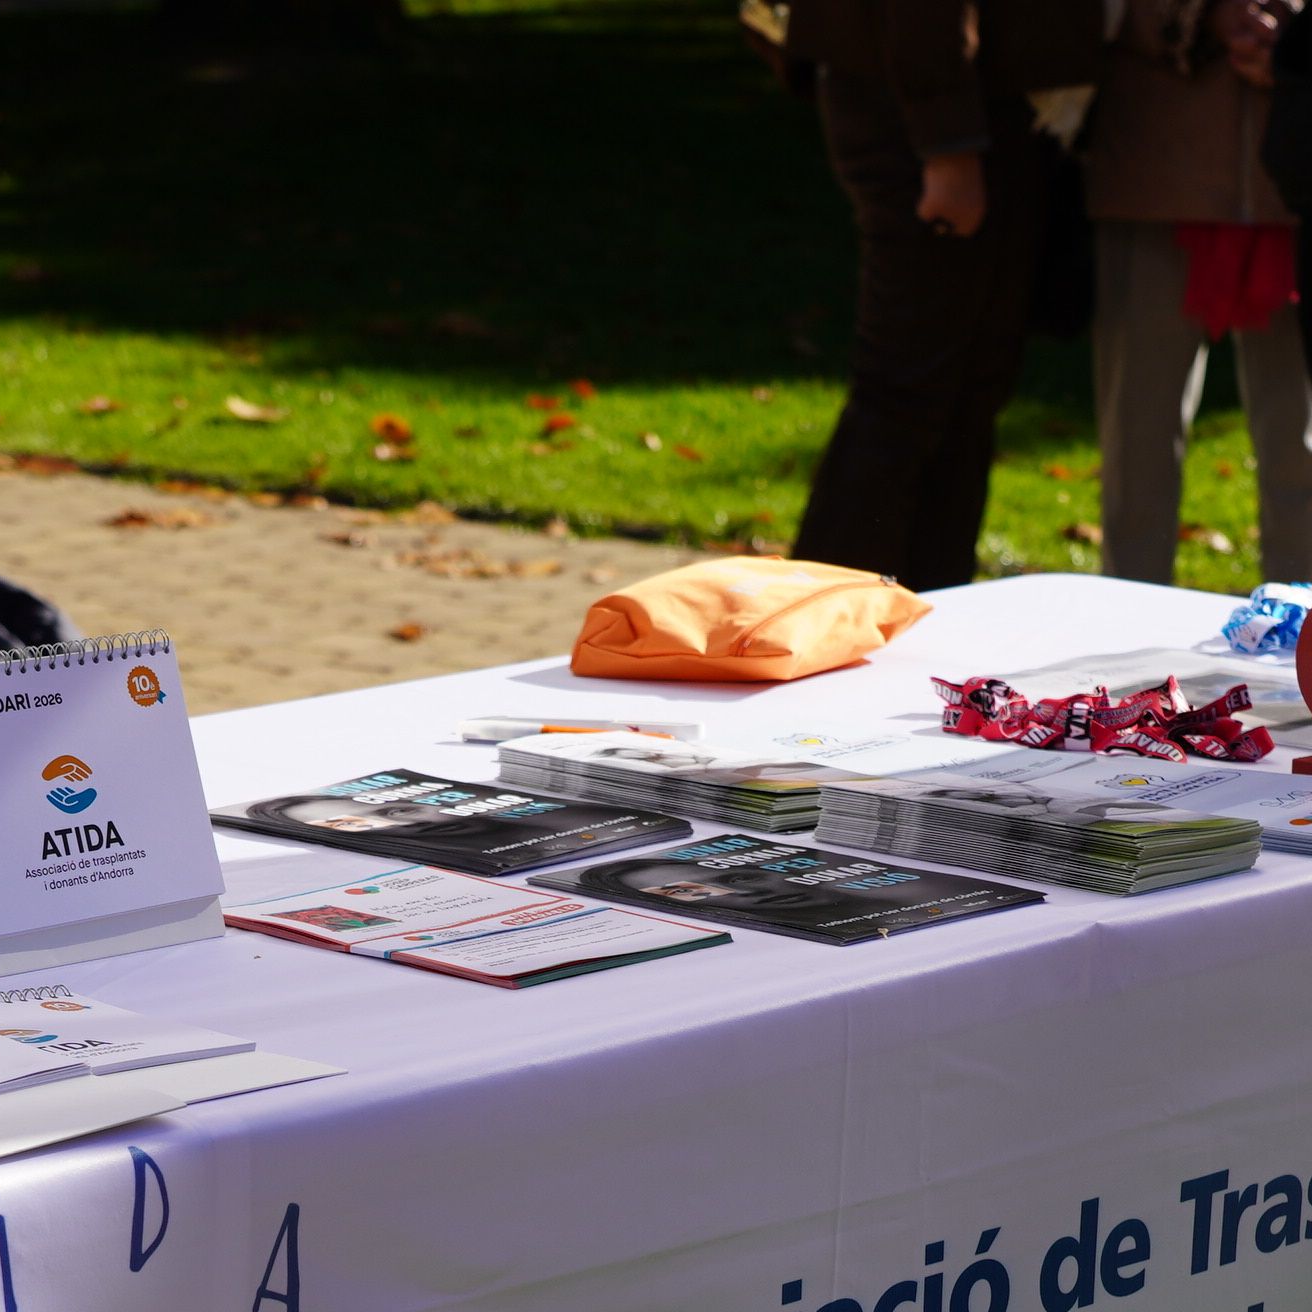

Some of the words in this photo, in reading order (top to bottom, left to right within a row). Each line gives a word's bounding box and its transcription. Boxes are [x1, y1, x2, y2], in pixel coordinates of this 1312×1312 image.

[34, 693, 63, 709] 2026
[322, 774, 408, 796] DONAR
[413, 791, 476, 806] PER
[438, 794, 535, 817] DONAR
[41, 820, 125, 860] ATIDA
[665, 838, 760, 861] DONAR
[25, 861, 77, 879] Associació
[78, 859, 91, 869] de
[93, 850, 147, 866] trasplantats
[697, 845, 807, 870] CÒRNIA
[760, 857, 828, 873] PER
[49, 876, 89, 890] donants
[90, 867, 135, 882] d'Andorra
[784, 862, 888, 886] DONAR
[836, 872, 921, 891] VISIÓ
[37, 1039, 113, 1054] TIDA
